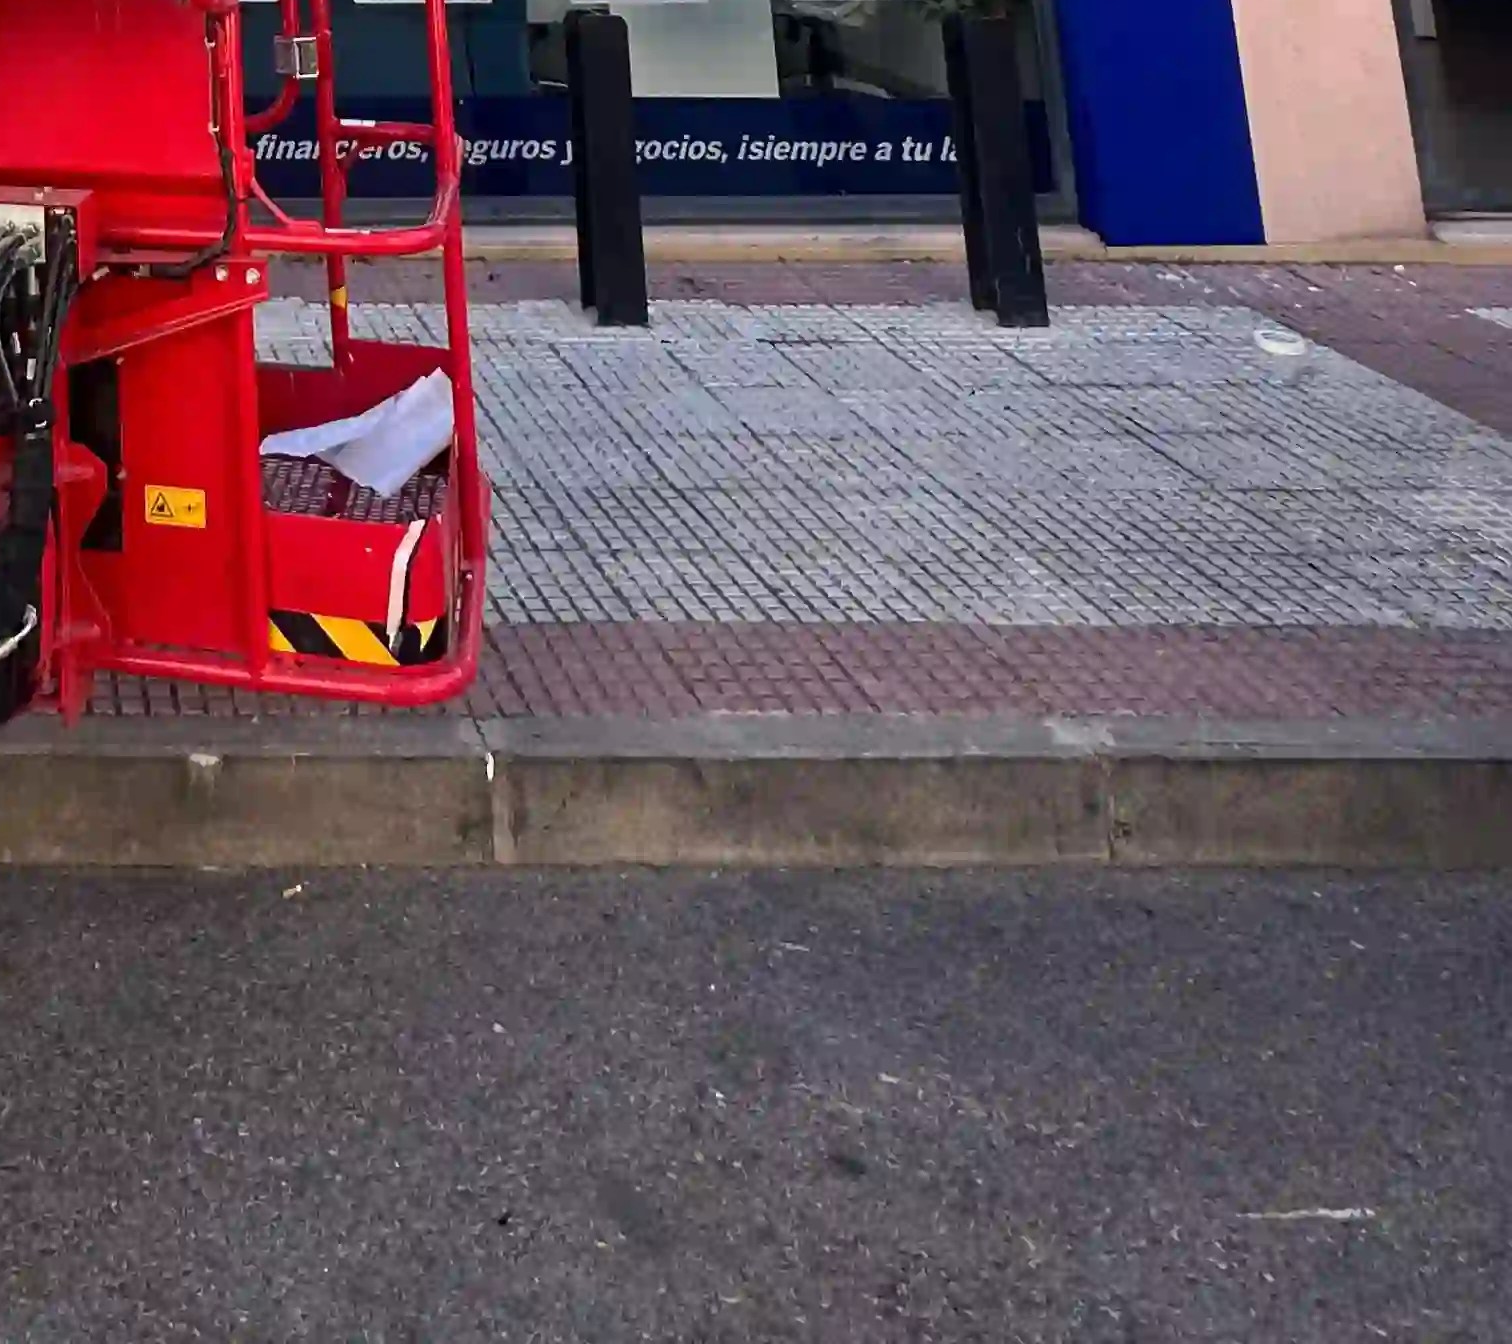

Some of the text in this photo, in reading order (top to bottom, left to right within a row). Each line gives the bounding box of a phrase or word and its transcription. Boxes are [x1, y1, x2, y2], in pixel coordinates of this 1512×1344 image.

[463, 139, 557, 166] eguros
[635, 135, 728, 164] ocios,
[875, 140, 892, 162] a
[901, 137, 933, 162] tu
